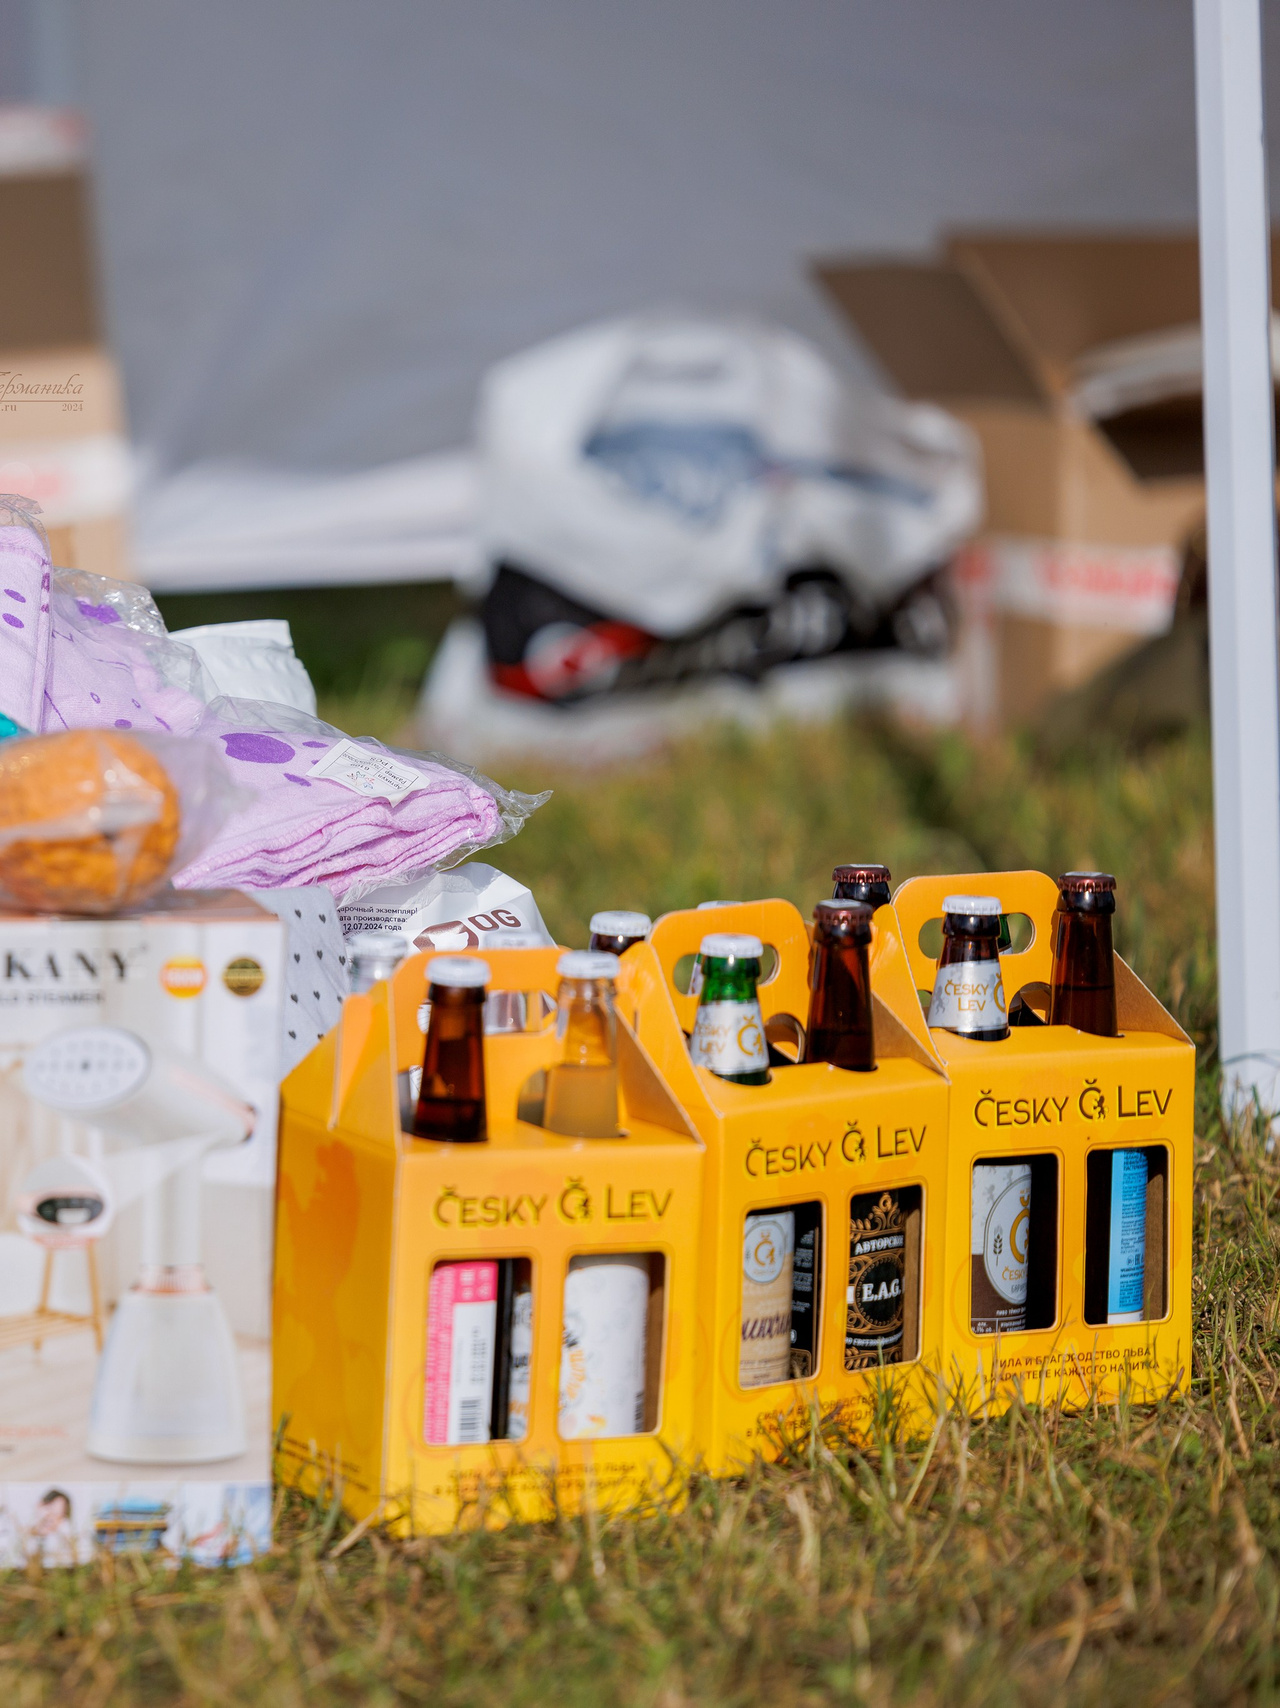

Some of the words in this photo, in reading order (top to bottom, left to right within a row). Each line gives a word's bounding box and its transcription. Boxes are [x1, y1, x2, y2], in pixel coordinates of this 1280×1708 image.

[375, 907, 418, 916] экземпляр!
[353, 915, 408, 923] производства:
[342, 922, 383, 931] 12.07.2024
[957, 997, 987, 1011] LEV
[974, 1089, 1070, 1127] ČESKY
[1117, 1085, 1174, 1118] LEV
[745, 1137, 833, 1177] ČESKY
[877, 1125, 927, 1158] LEV
[434, 1185, 548, 1225] ČESKY
[606, 1183, 673, 1219] LEV
